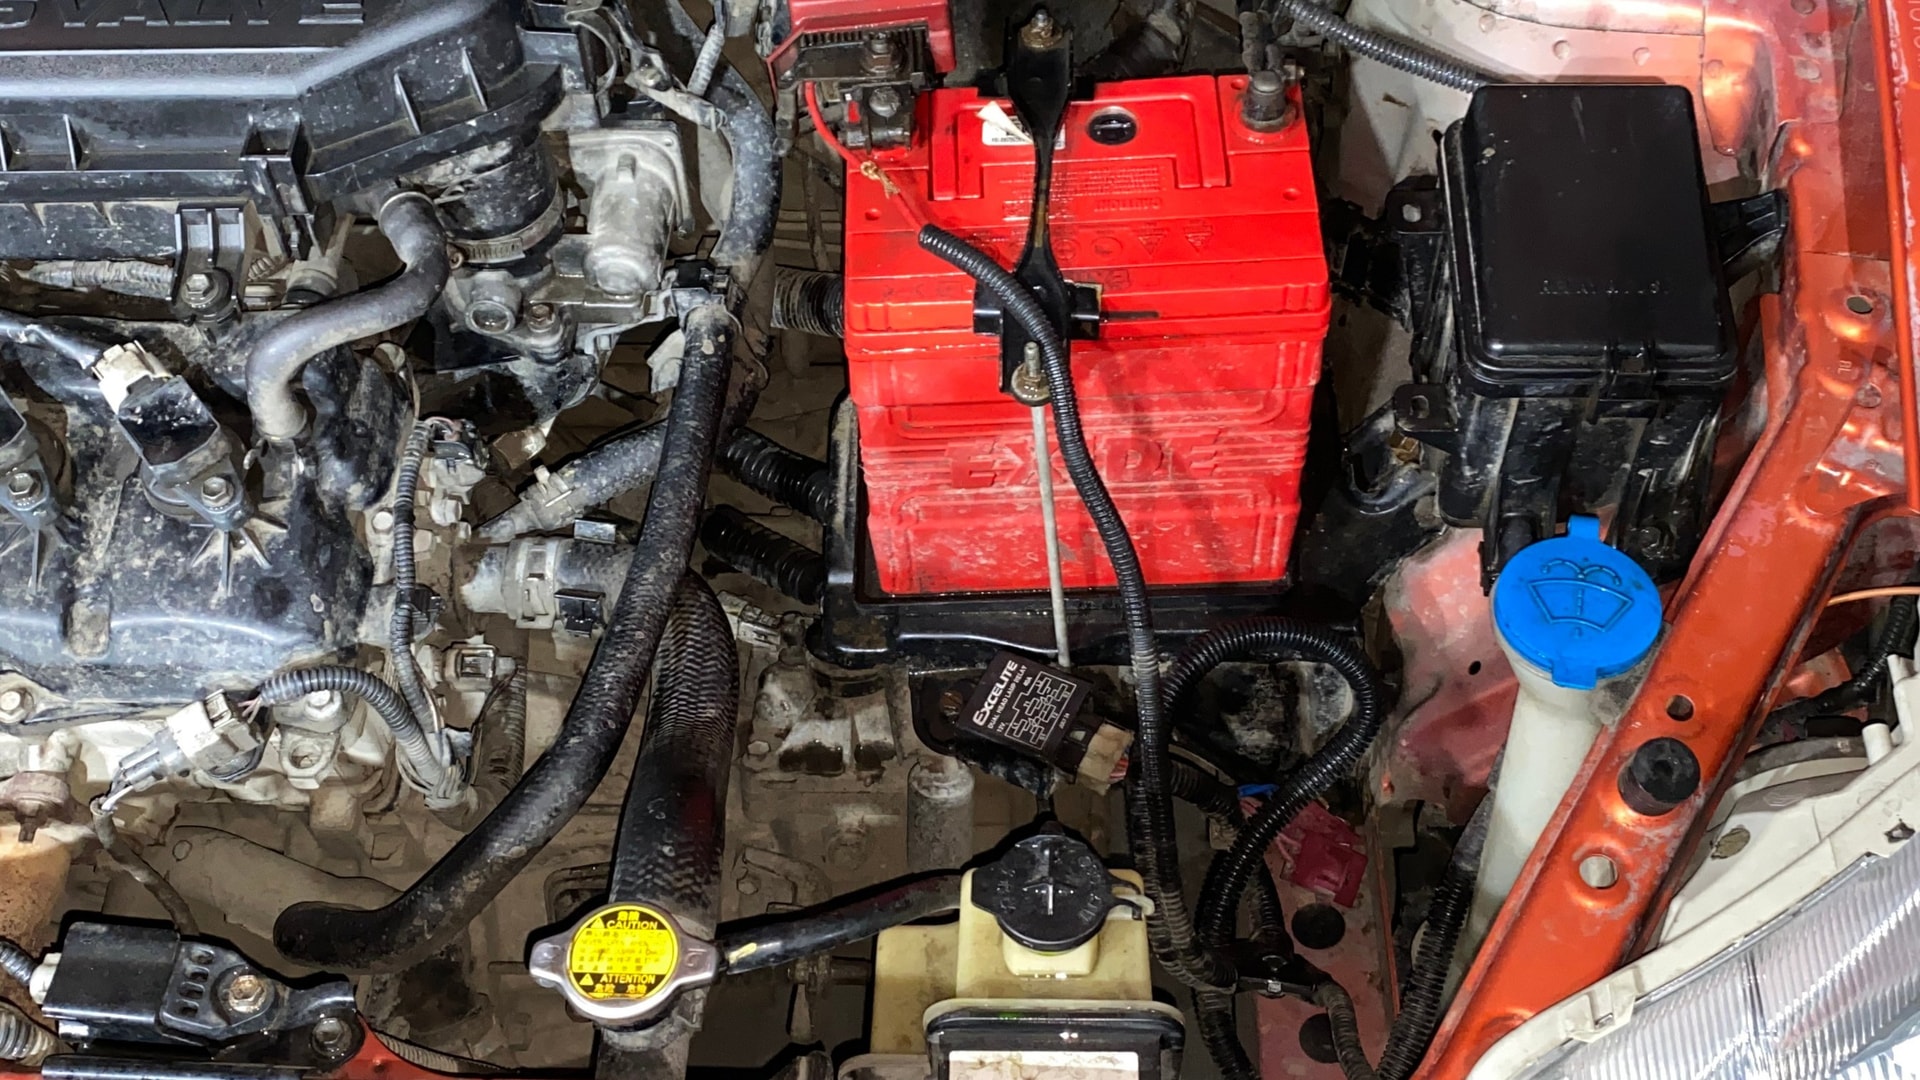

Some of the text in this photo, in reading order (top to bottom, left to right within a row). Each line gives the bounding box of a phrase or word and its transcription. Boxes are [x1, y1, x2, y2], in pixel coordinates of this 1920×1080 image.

[946, 427, 1220, 489] EXDE
[972, 660, 1018, 726] EXCELITE
[606, 920, 658, 929] CAUTION
[600, 973, 656, 984] ATTENTION
